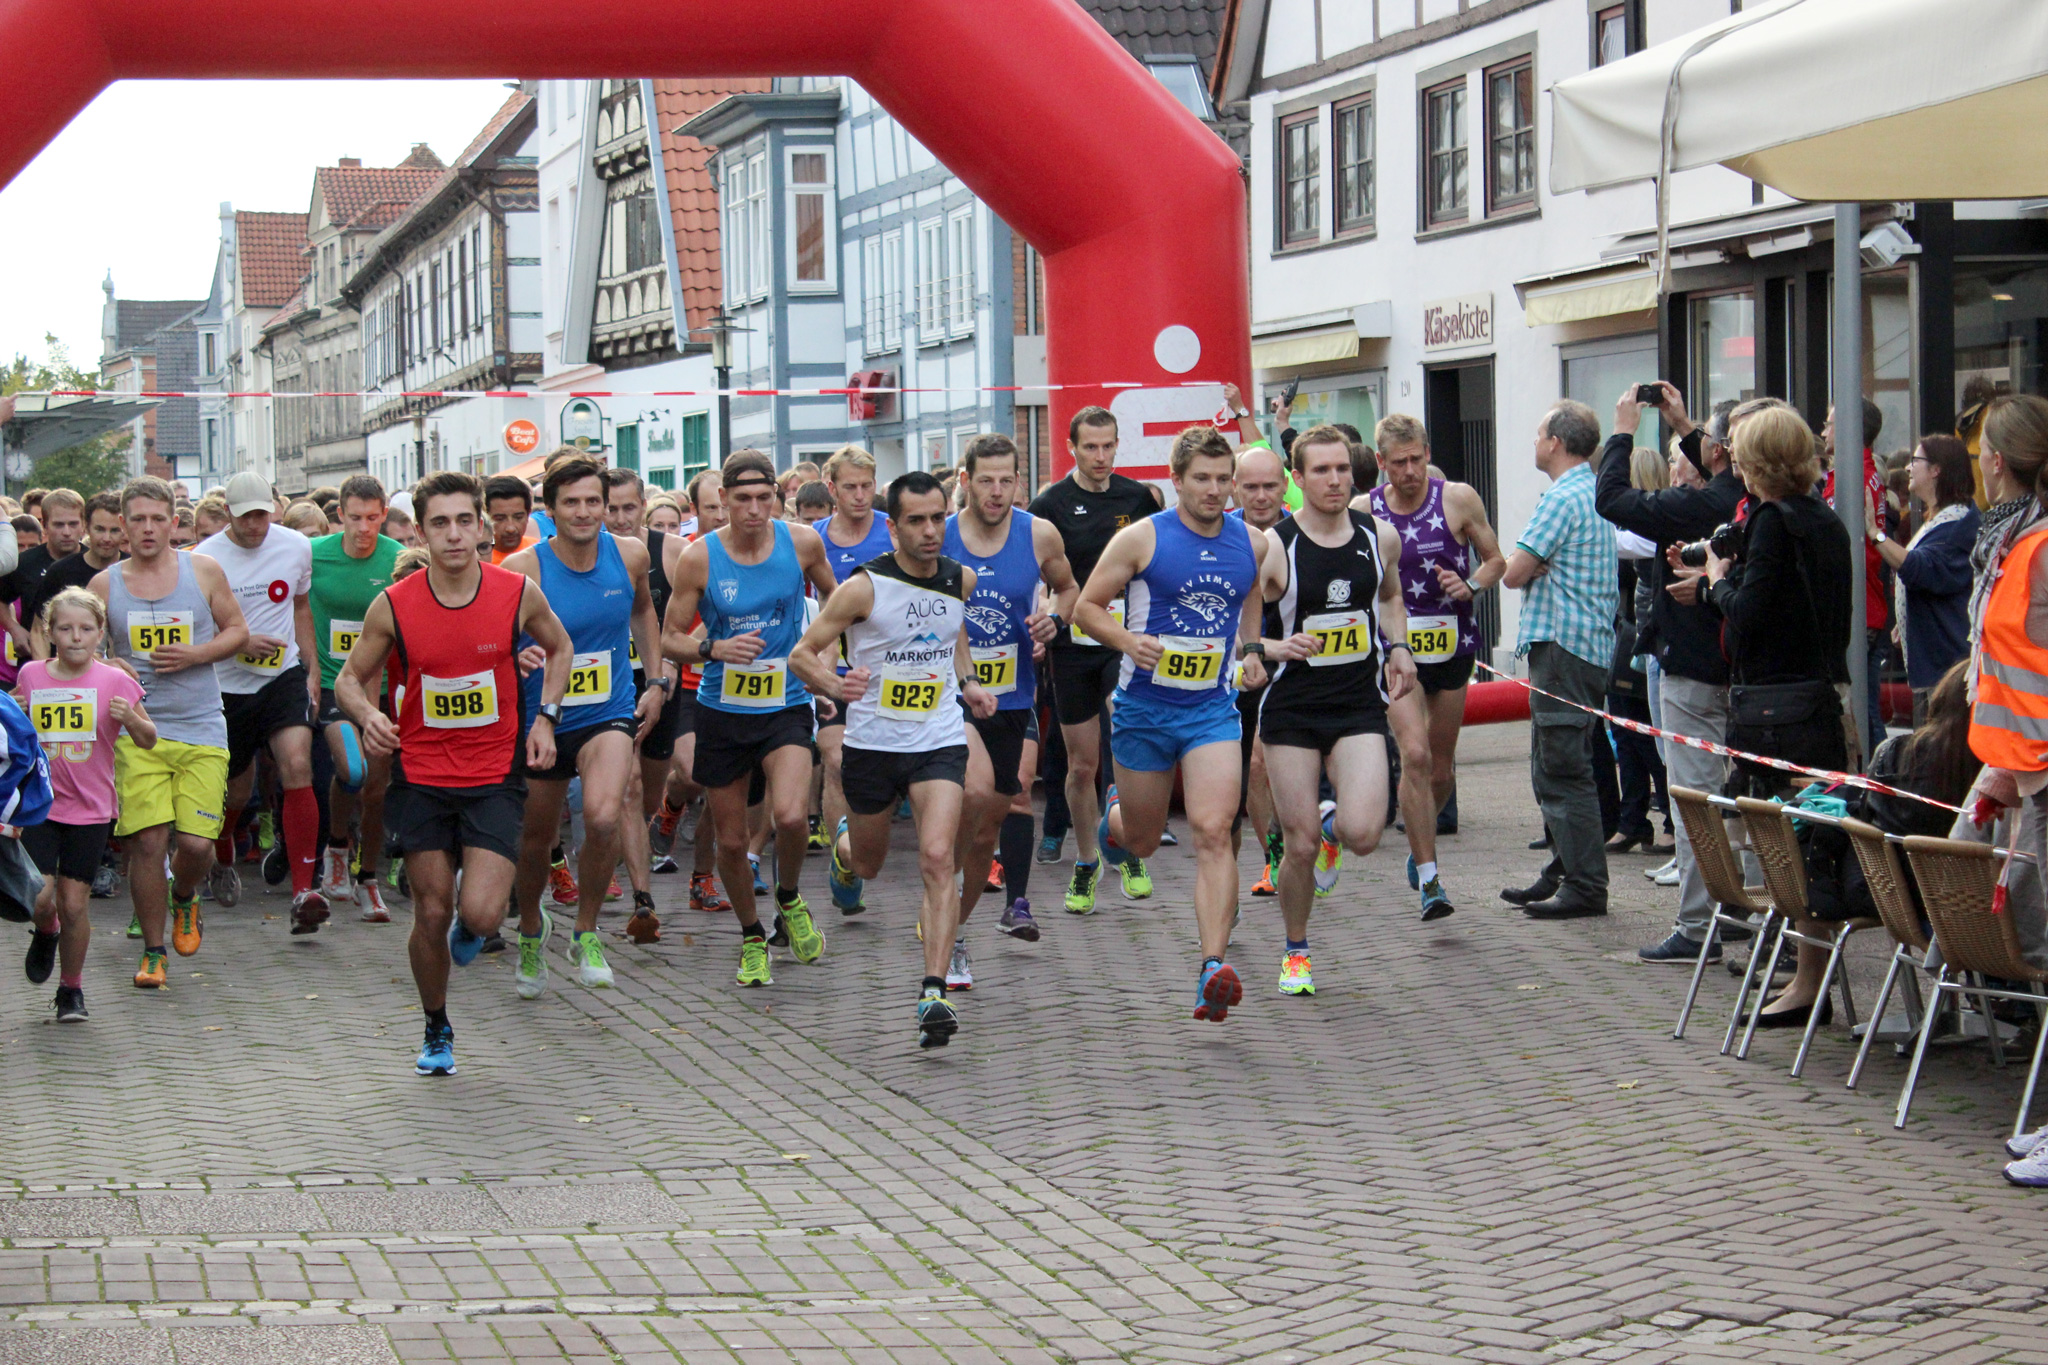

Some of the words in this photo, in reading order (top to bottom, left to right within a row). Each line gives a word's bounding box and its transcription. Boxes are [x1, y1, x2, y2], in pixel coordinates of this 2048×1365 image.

[1423, 302, 1490, 346] Käsekiste
[510, 426, 536, 436] Beat
[514, 435, 537, 446] Café
[723, 586, 738, 602] TSV
[1180, 579, 1193, 593] TV
[1198, 574, 1237, 597] LEMGO
[905, 598, 947, 619] AÜG
[976, 589, 1012, 609] LEMGO
[728, 614, 760, 624] Rechts
[729, 619, 781, 631] Centrum.de
[1170, 607, 1191, 632] LAZY
[1196, 612, 1230, 636] TIGERS
[140, 628, 181, 649] 516
[477, 643, 497, 651] GORE
[978, 624, 1012, 647] TIGERS
[1316, 629, 1359, 654] 774
[1411, 631, 1448, 653] 534
[1168, 654, 1212, 678] 957
[565, 670, 599, 694] 21
[735, 673, 773, 696] 791
[434, 692, 484, 717] 998
[891, 684, 936, 709] 923
[41, 706, 83, 729] 515
